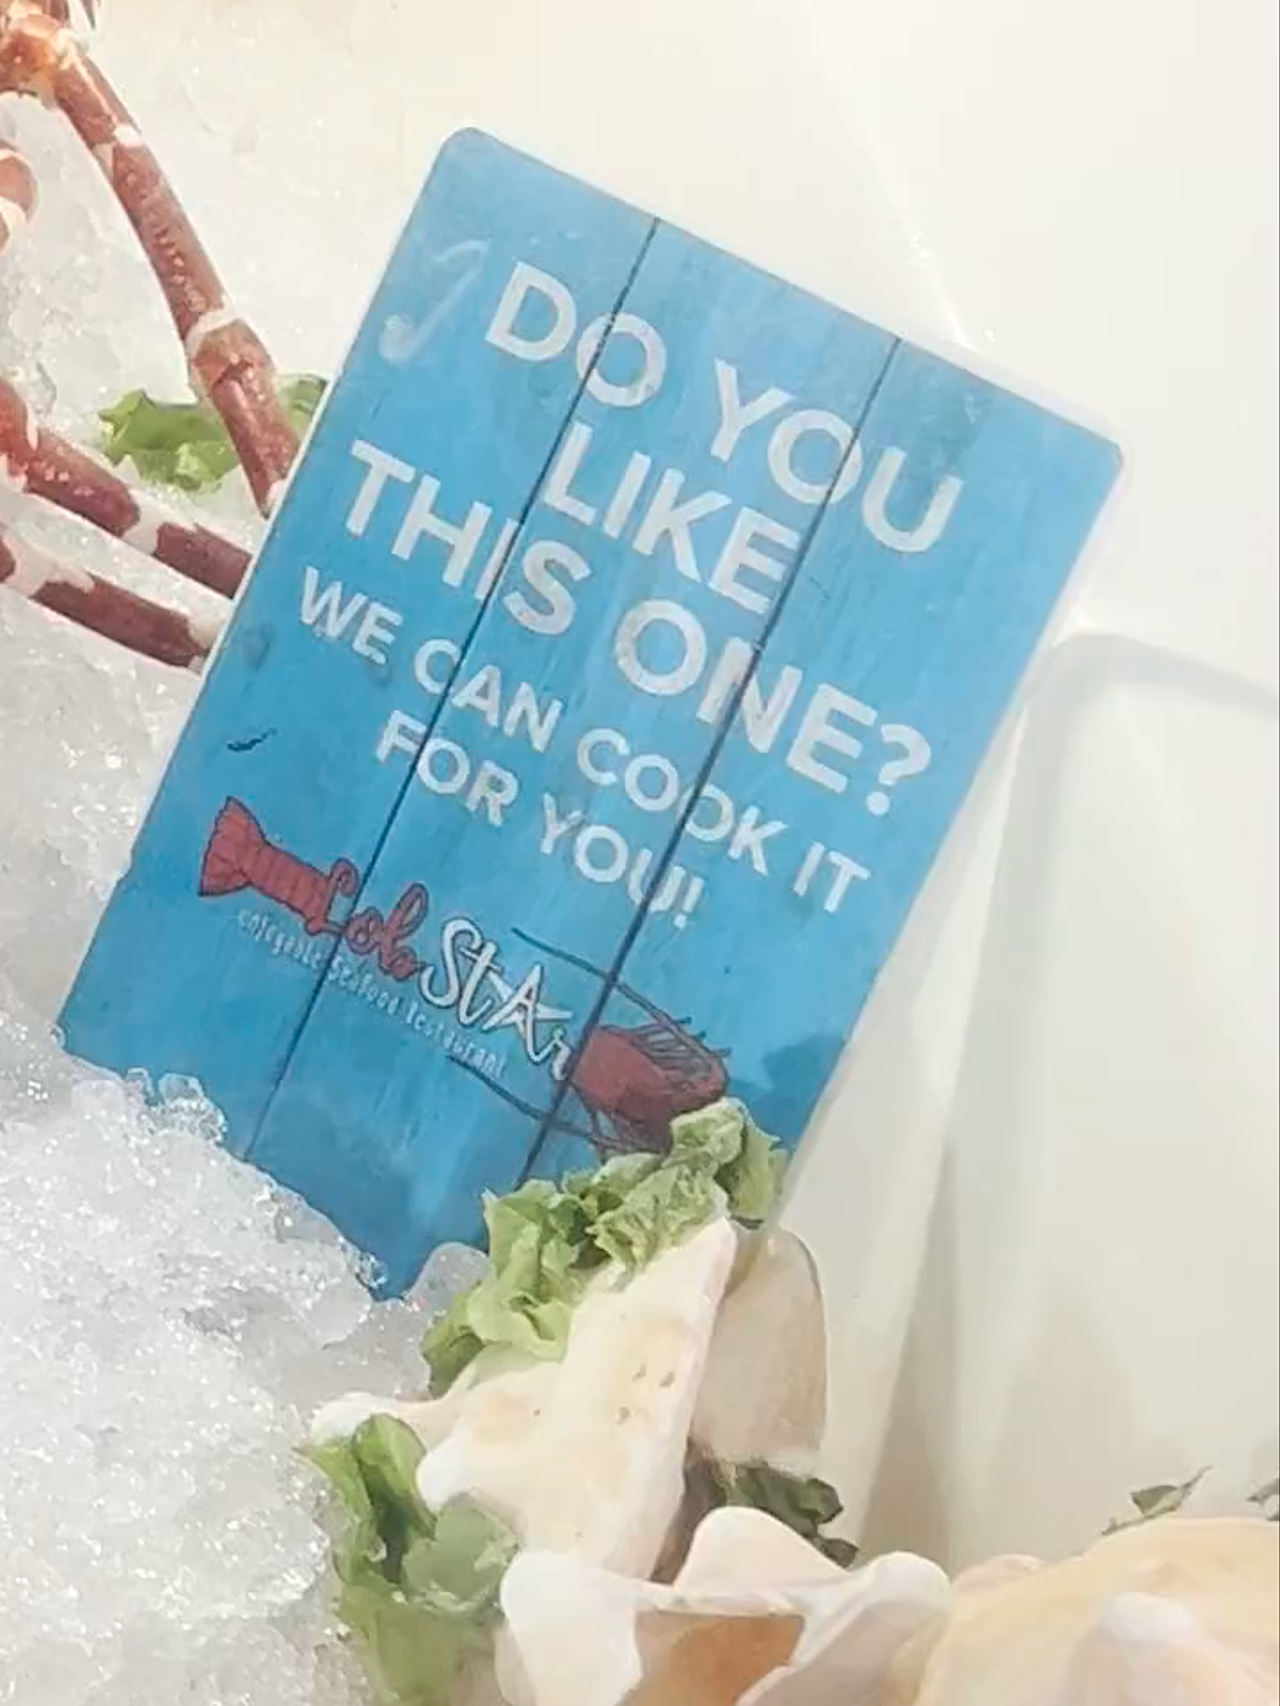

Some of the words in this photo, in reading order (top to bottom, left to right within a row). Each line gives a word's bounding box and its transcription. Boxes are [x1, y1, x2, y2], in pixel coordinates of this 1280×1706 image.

[485, 261, 665, 406] DO
[710, 357, 962, 552] YOU
[542, 421, 799, 613] LIKE
[301, 566, 402, 663] WE
[414, 639, 561, 752] CAN
[576, 728, 786, 874] COOK
[793, 841, 870, 912] IT
[346, 439, 590, 634] THIS
[614, 598, 931, 815] ONE?
[375, 709, 517, 825] FOR
[540, 793, 703, 928] YOU!
